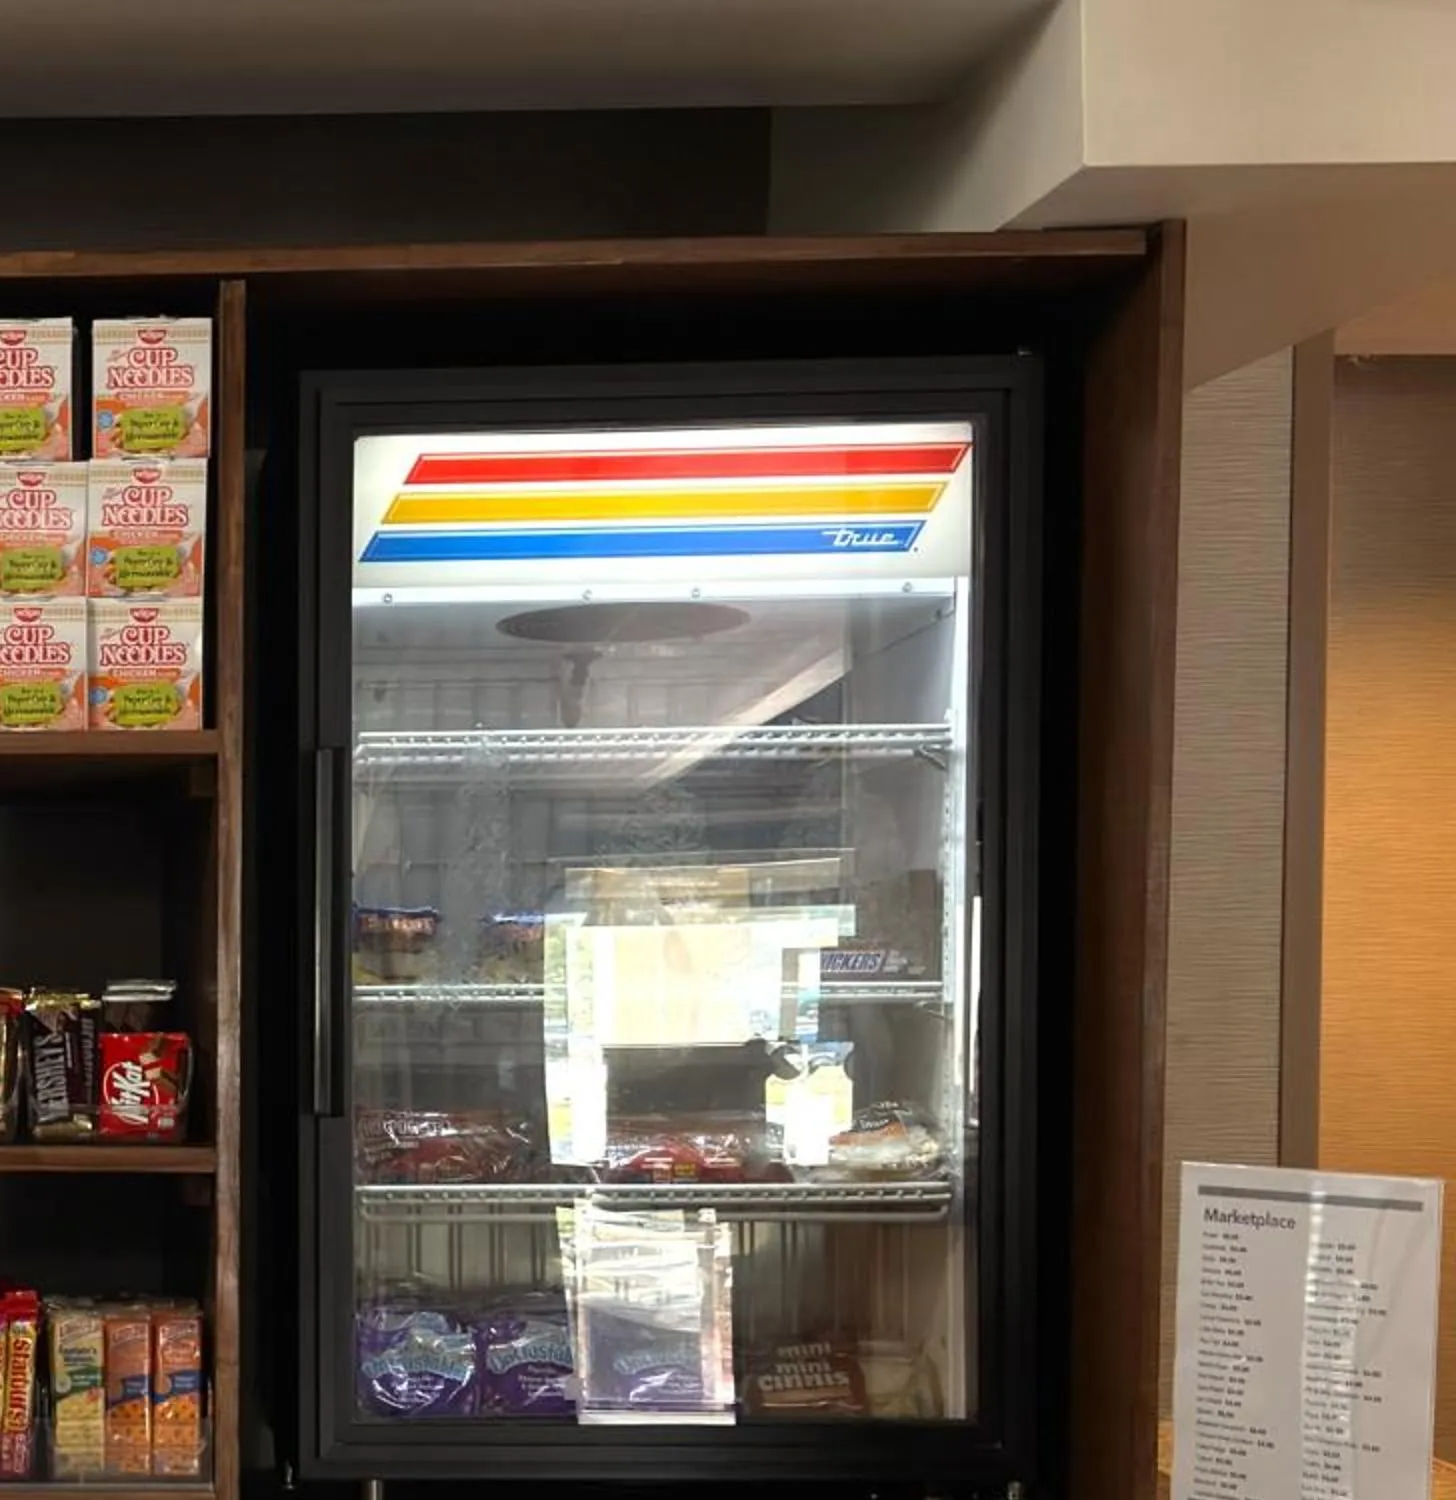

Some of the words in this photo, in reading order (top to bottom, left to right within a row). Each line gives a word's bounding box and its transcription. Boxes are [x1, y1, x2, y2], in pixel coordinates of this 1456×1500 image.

[128, 348, 178, 368] CUP
[107, 366, 194, 389] NOODLES
[7, 489, 56, 509] CUP
[122, 486, 172, 508] CUP
[102, 504, 189, 527] NOODLES
[821, 528, 900, 547] True
[4, 625, 54, 645] CUP
[121, 625, 170, 646] CUP
[100, 643, 186, 666] NOODLES
[1204, 1207, 1296, 1230] Marketplace
